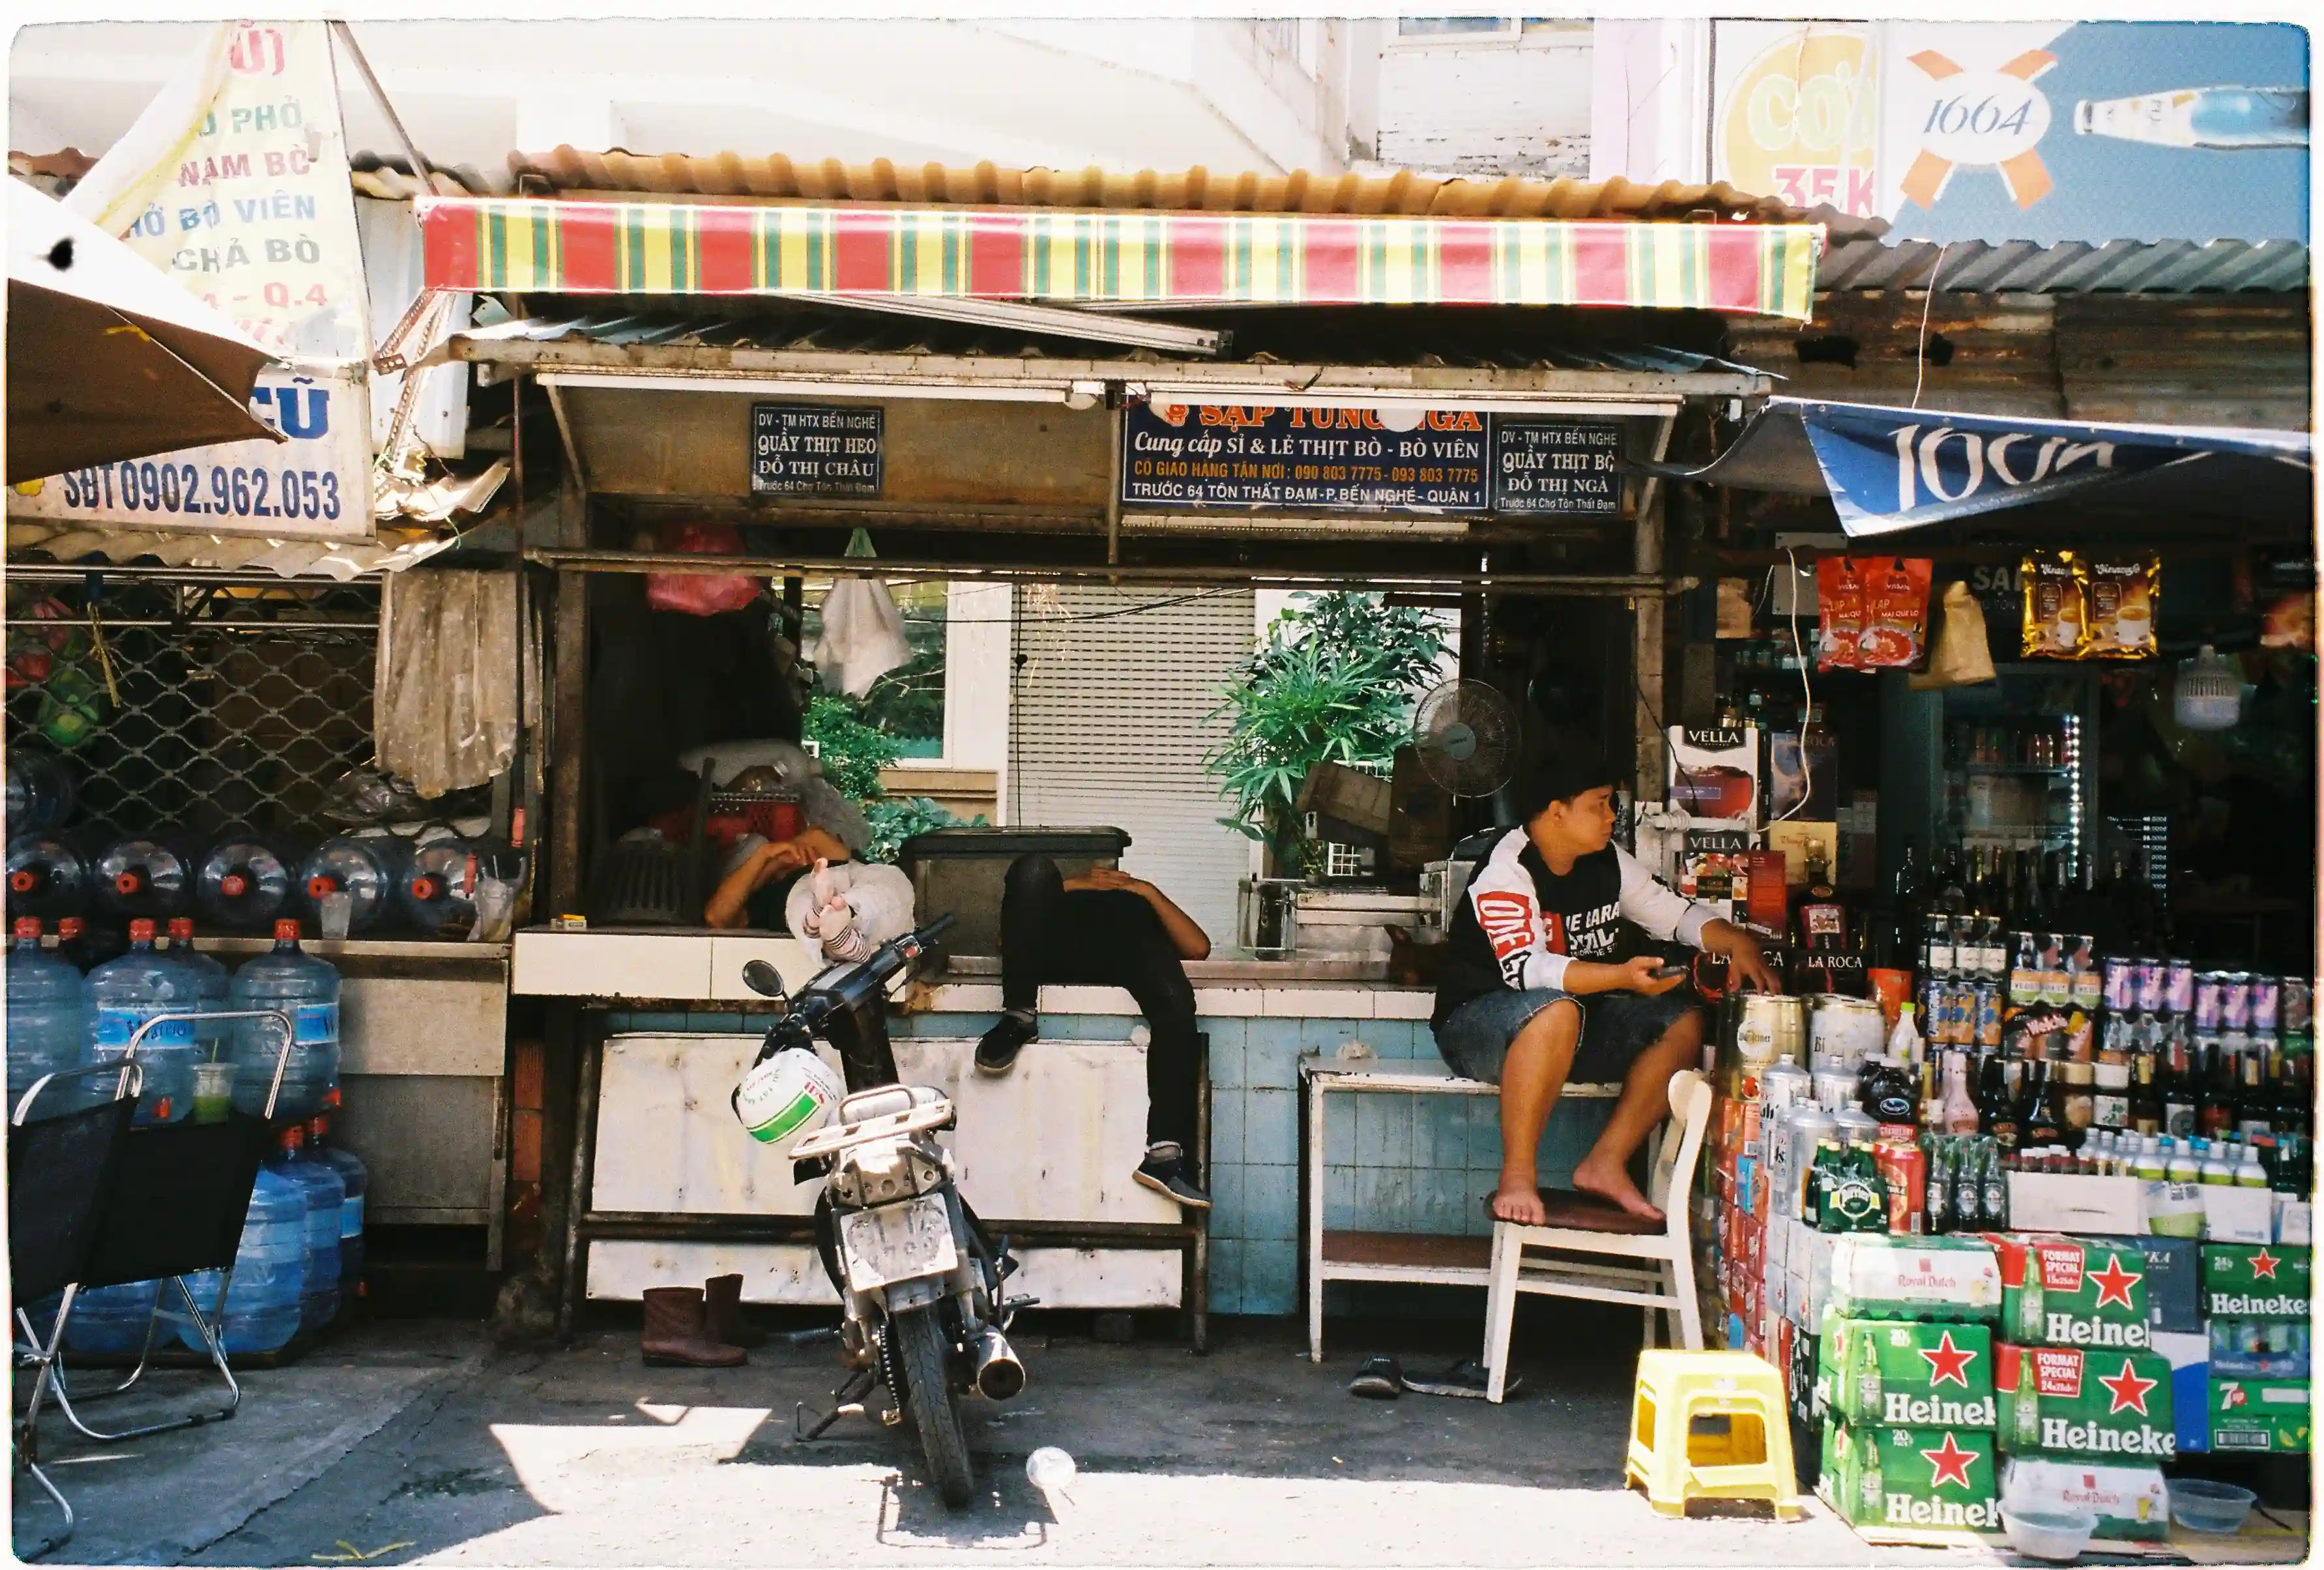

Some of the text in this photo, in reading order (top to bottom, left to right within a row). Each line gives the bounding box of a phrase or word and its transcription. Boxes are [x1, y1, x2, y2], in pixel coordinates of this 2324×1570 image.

[1923, 91, 2032, 137] 1664
[233, 189, 315, 224] VIÊN
[264, 233, 321, 264] BÒ
[782, 414, 796, 428] TM
[800, 414, 820, 428] HTX
[758, 426, 877, 457] QUẦY THỊT HEO
[1135, 431, 1184, 458] Cung
[1187, 429, 1223, 459] cấp
[1227, 433, 1245, 455] SỈ
[1250, 438, 1266, 455] &
[1271, 434, 1294, 455] LẺ
[1299, 439, 1350, 460] THỊT
[1354, 436, 1382, 458] BÒ
[1399, 437, 1427, 458] BÒ
[1432, 438, 1479, 459] VIÊN
[1501, 431, 1515, 444] DV
[1524, 431, 1539, 444] TM
[1541, 431, 1561, 444] HTX
[759, 454, 875, 478] ĐỖ THỊ CHÂU
[1502, 444, 1548, 473] QUẦY
[1551, 453, 1590, 474] THỊT
[1155, 460, 1187, 478] GIAO
[1294, 464, 1319, 480] 090
[1322, 465, 1346, 482] 803
[1391, 467, 1416, 483] 093
[1419, 468, 1443, 483] 803
[1447, 468, 1479, 484] 7775
[1507, 471, 1609, 495] ĐỖ THỊ NGÀ
[1132, 478, 1183, 498] TRƯỚC
[1187, 485, 1204, 498] 64
[1207, 482, 1238, 500] TÔN
[1242, 481, 1281, 499] THẤT
[1427, 487, 1469, 506] QUẬN
[1474, 491, 1480, 504] 1
[1689, 730, 1739, 743] VELLA
[1690, 837, 1741, 849] VELLA
[1808, 956, 1863, 968] LA ROCA
[2042, 1249, 2080, 1262] FORMAT
[2045, 1261, 2080, 1273] SPECIAL
[2037, 1352, 2080, 1367] FORMAT
[2040, 1365, 2078, 1379] SPECIAL
